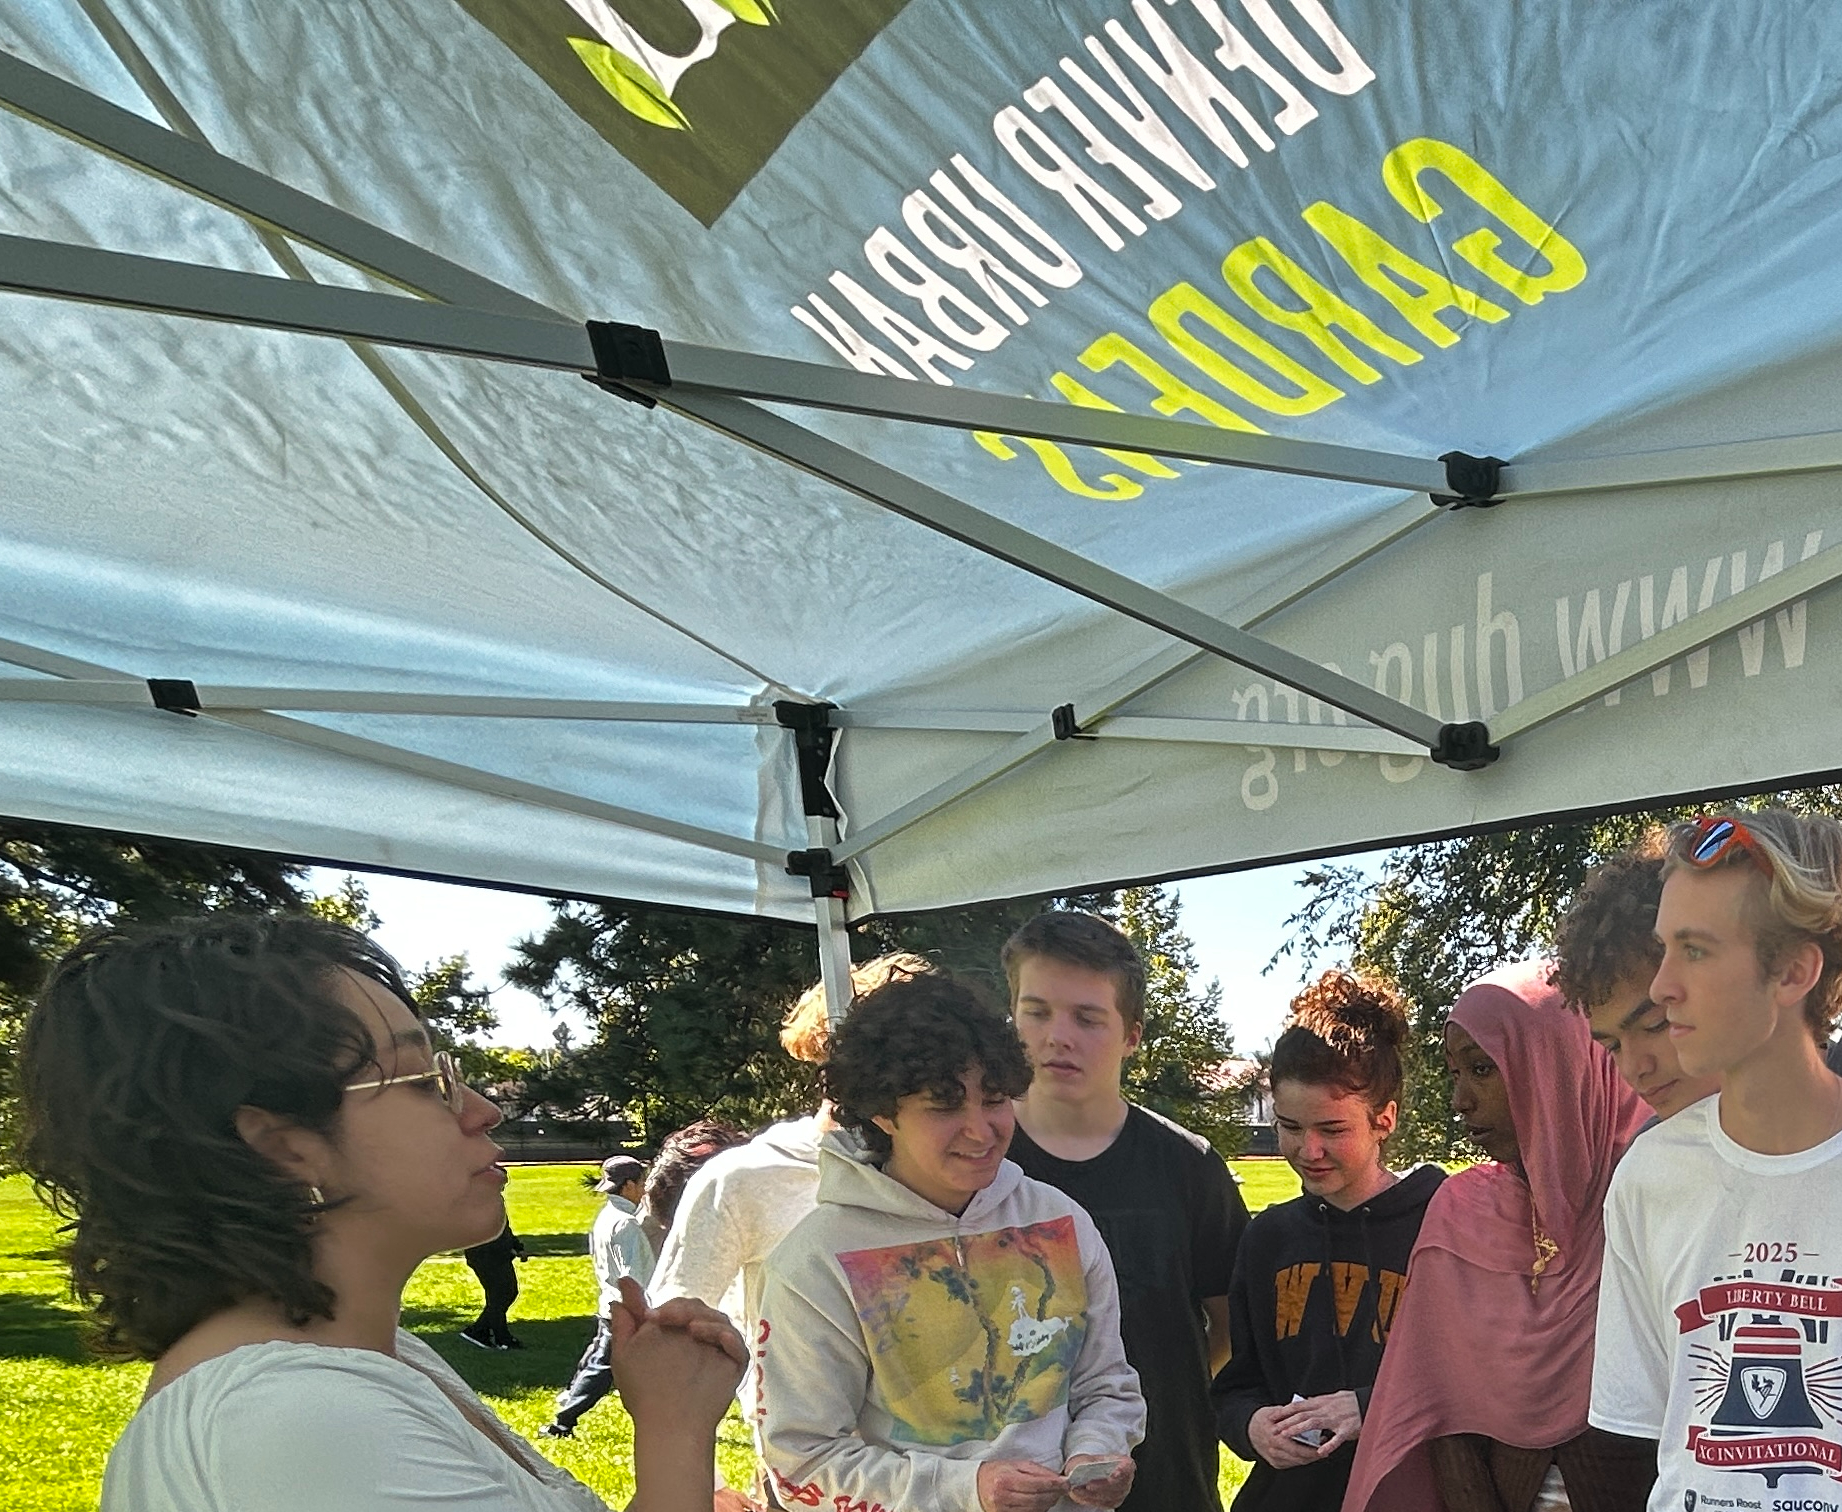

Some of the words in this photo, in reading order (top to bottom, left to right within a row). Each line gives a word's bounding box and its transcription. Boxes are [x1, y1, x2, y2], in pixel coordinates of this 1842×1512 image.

[1744, 1242, 1798, 1262] 2025
[1726, 1289, 1786, 1306] LIBERTY
[1790, 1294, 1828, 1312] BELL
[1698, 1443, 1715, 1461] XC
[1716, 1442, 1836, 1464] INVITATIONAL
[1736, 1498, 1762, 1510] Roost
